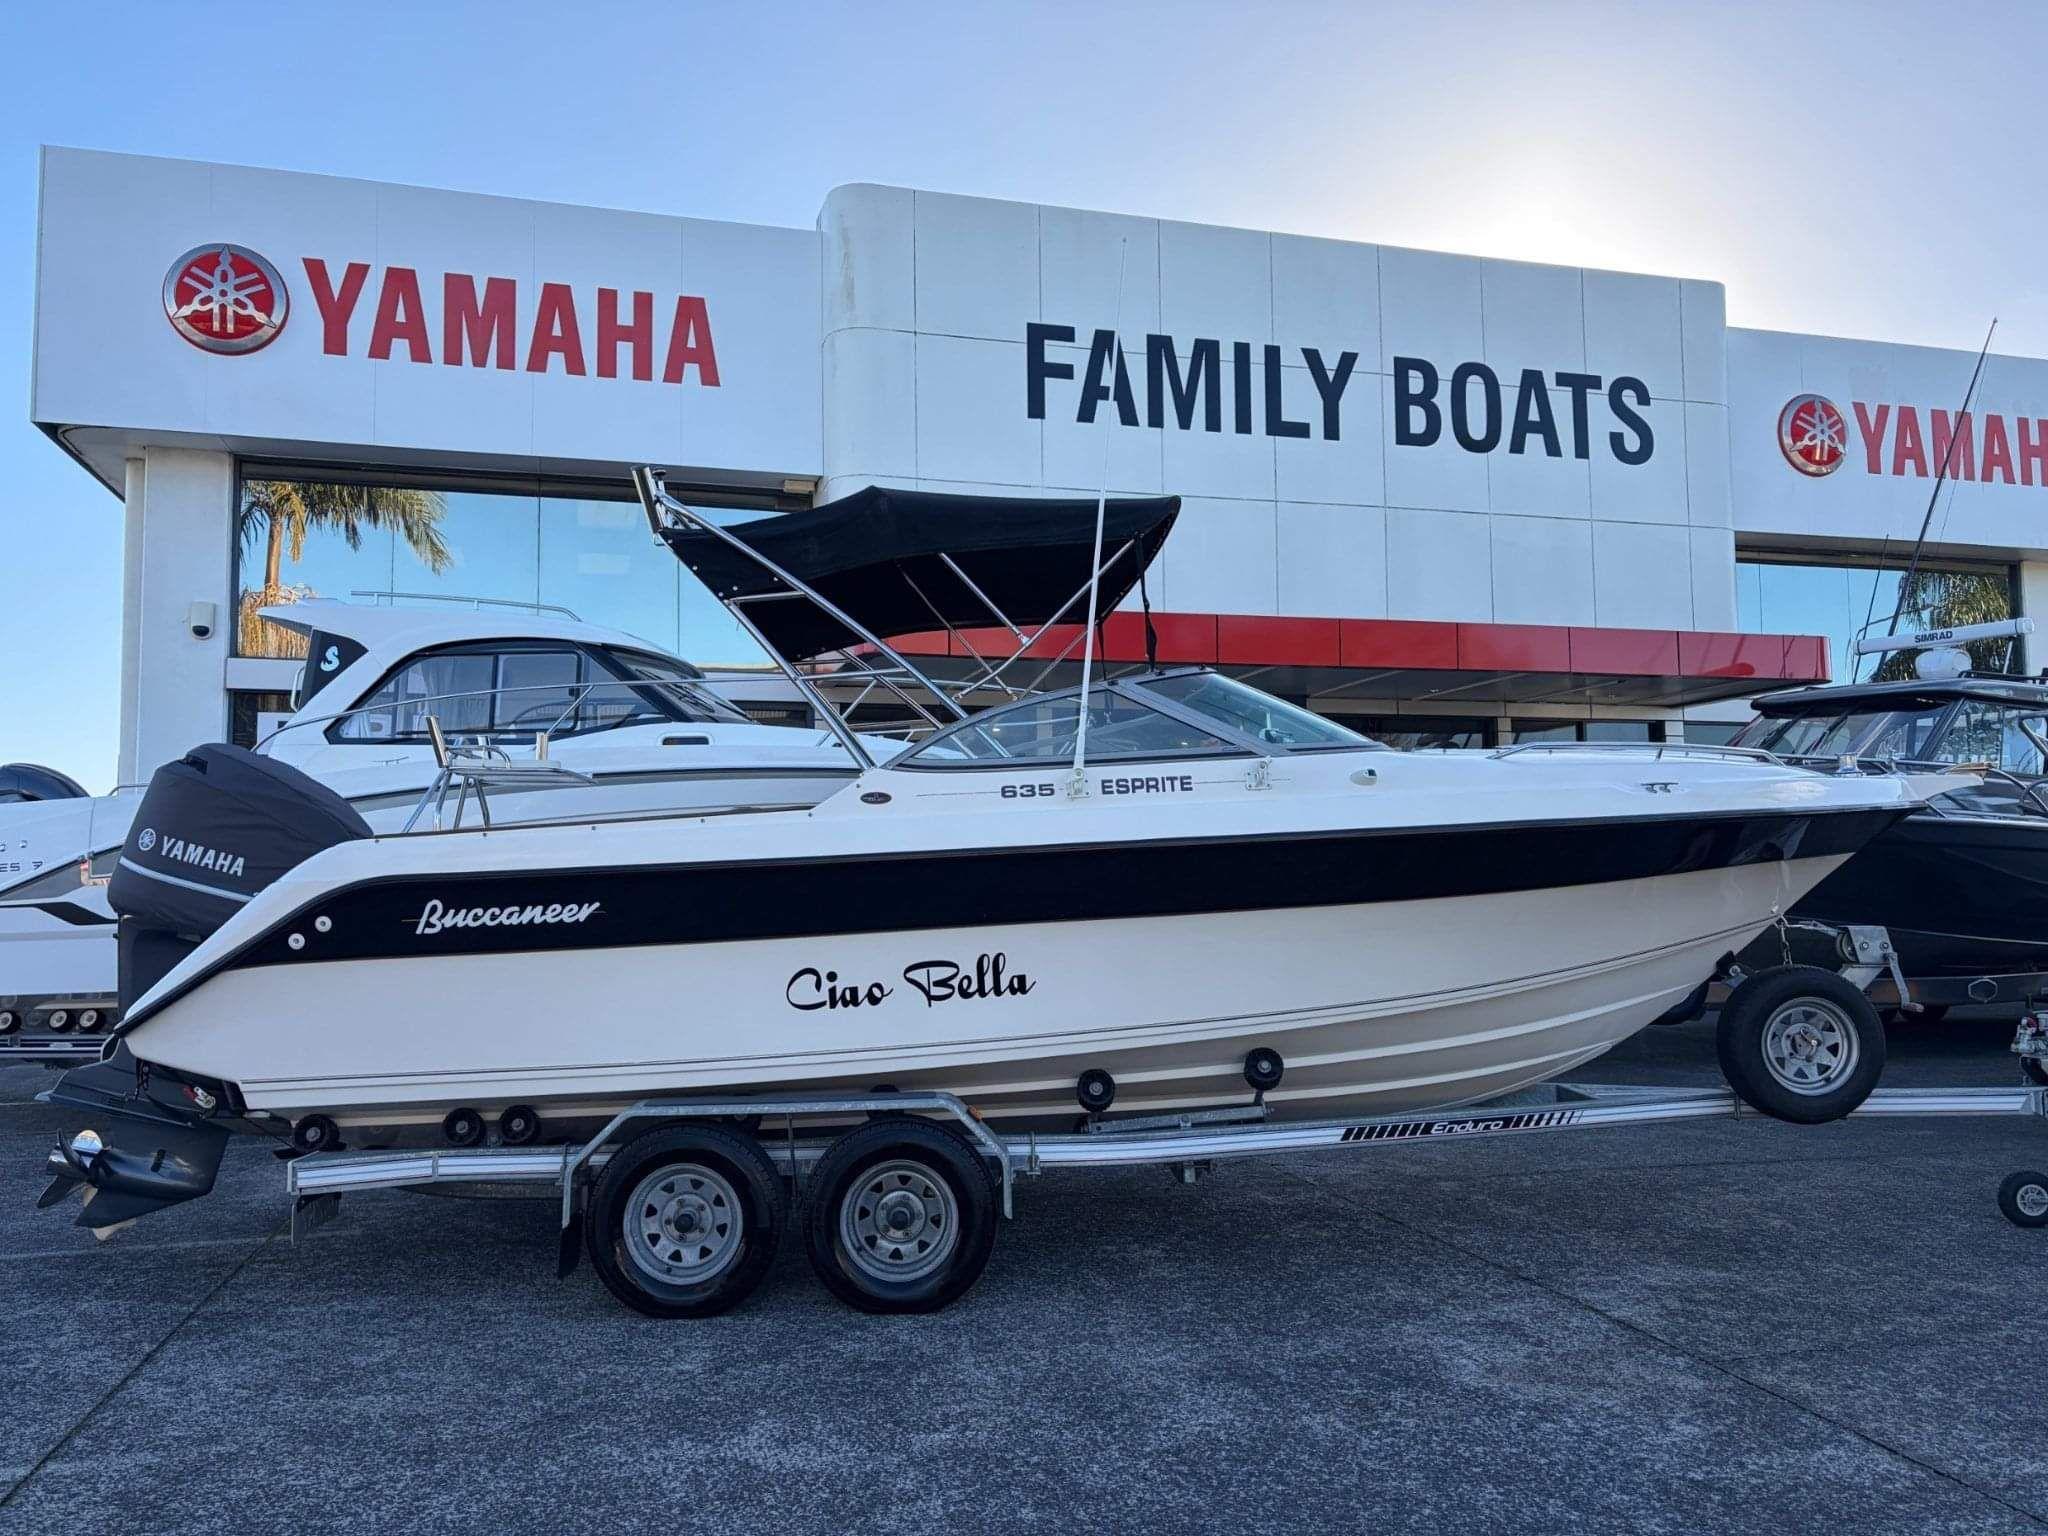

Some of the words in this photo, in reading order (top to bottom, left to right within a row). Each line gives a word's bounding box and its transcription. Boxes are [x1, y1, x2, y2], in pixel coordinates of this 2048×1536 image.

[301, 257, 721, 388] YAMAHA
[1026, 322, 1359, 442] FAMILY
[1393, 356, 1655, 466] BOATS
[1914, 630, 1954, 643] SIMRAD
[1000, 783, 1055, 799] 635
[1101, 775, 1193, 795] ESPRITE
[160, 835, 245, 877] YAMAHA
[415, 899, 601, 935] Buccaneer
[786, 967, 894, 1011] Ciao
[903, 952, 1036, 1008] Bella
[1430, 1120, 1504, 1134] Enduro
